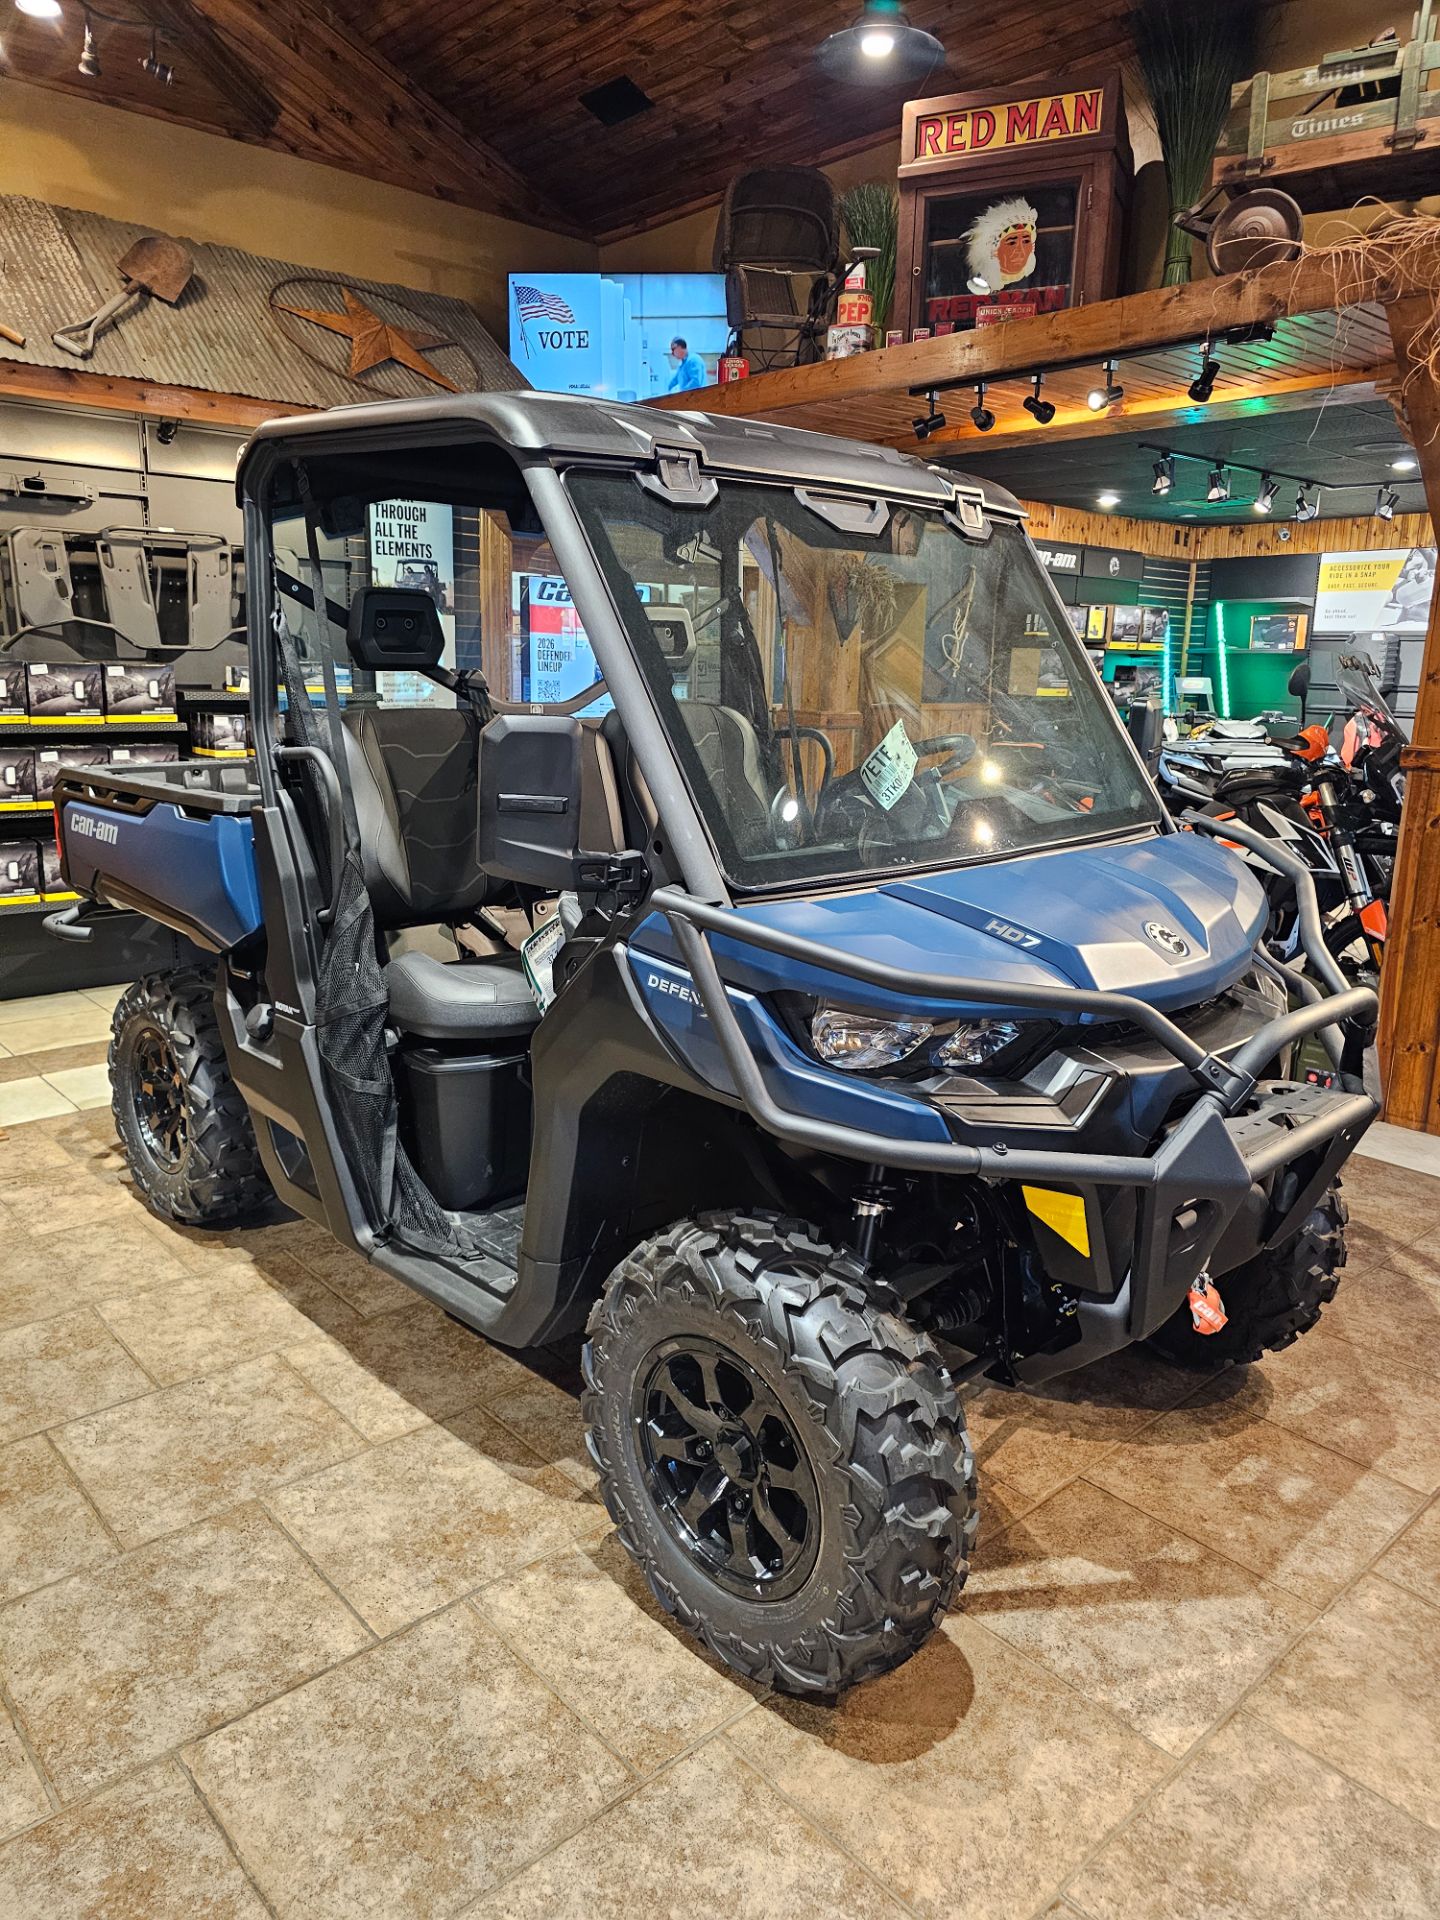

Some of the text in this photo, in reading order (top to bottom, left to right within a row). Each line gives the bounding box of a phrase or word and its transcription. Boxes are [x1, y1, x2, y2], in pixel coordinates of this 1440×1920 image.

[919, 91, 1101, 157] RED MAN
[1291, 112, 1366, 138] Times
[840, 302, 869, 322] PEP
[538, 330, 589, 350] VOTE
[374, 503, 427, 523] THROUGH
[374, 521, 418, 540] ALL THE
[375, 540, 433, 559] ELEMENTS
[537, 638, 555, 650] 2026
[537, 661, 563, 673] LINEUP
[71, 813, 119, 845] can-am
[985, 918, 1042, 948] HD7
[647, 973, 705, 1008] DEFEN
